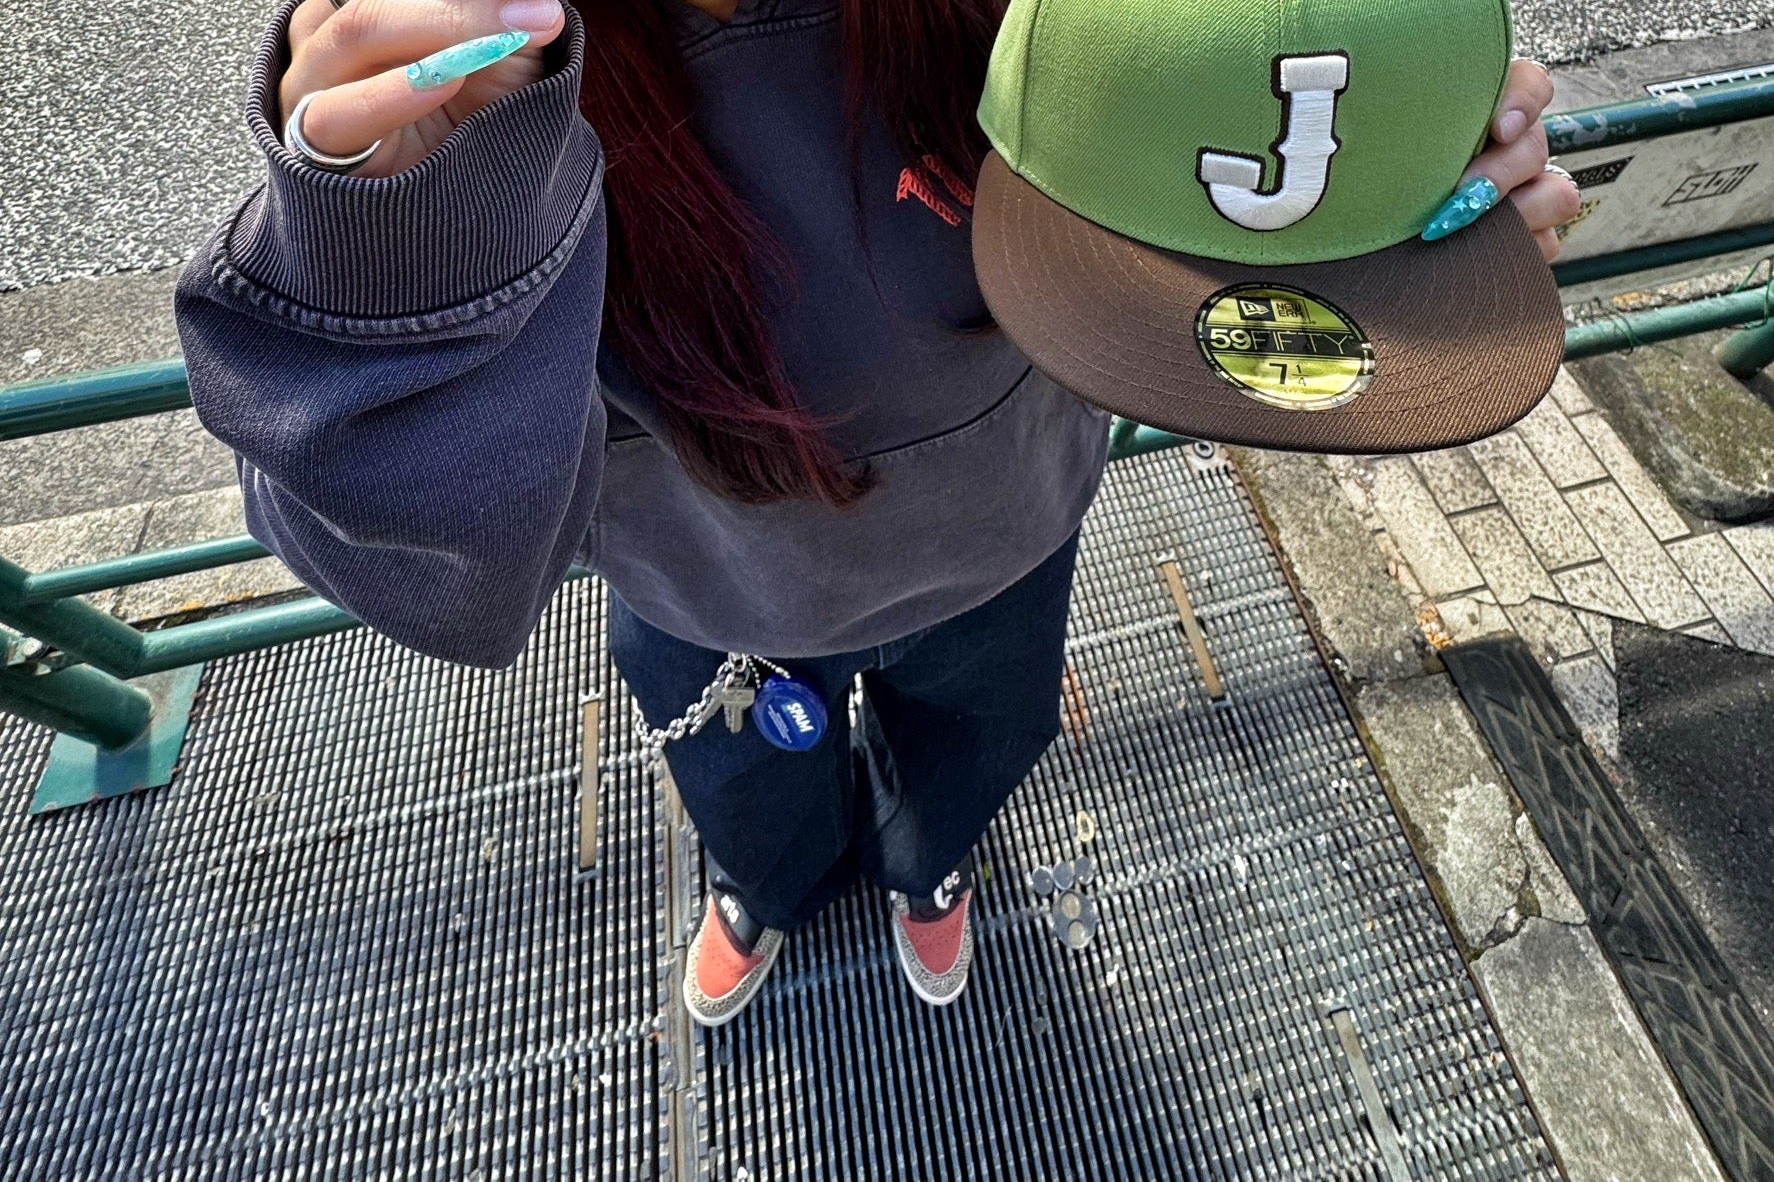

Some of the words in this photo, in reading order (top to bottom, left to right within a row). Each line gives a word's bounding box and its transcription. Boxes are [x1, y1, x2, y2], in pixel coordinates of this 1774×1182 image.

[1196, 49, 1350, 232] J
[1276, 302, 1301, 312] NEW
[1278, 309, 1304, 319] ERA
[1210, 328, 1350, 355] 59FIFTY
[785, 702, 815, 733] SPAM
